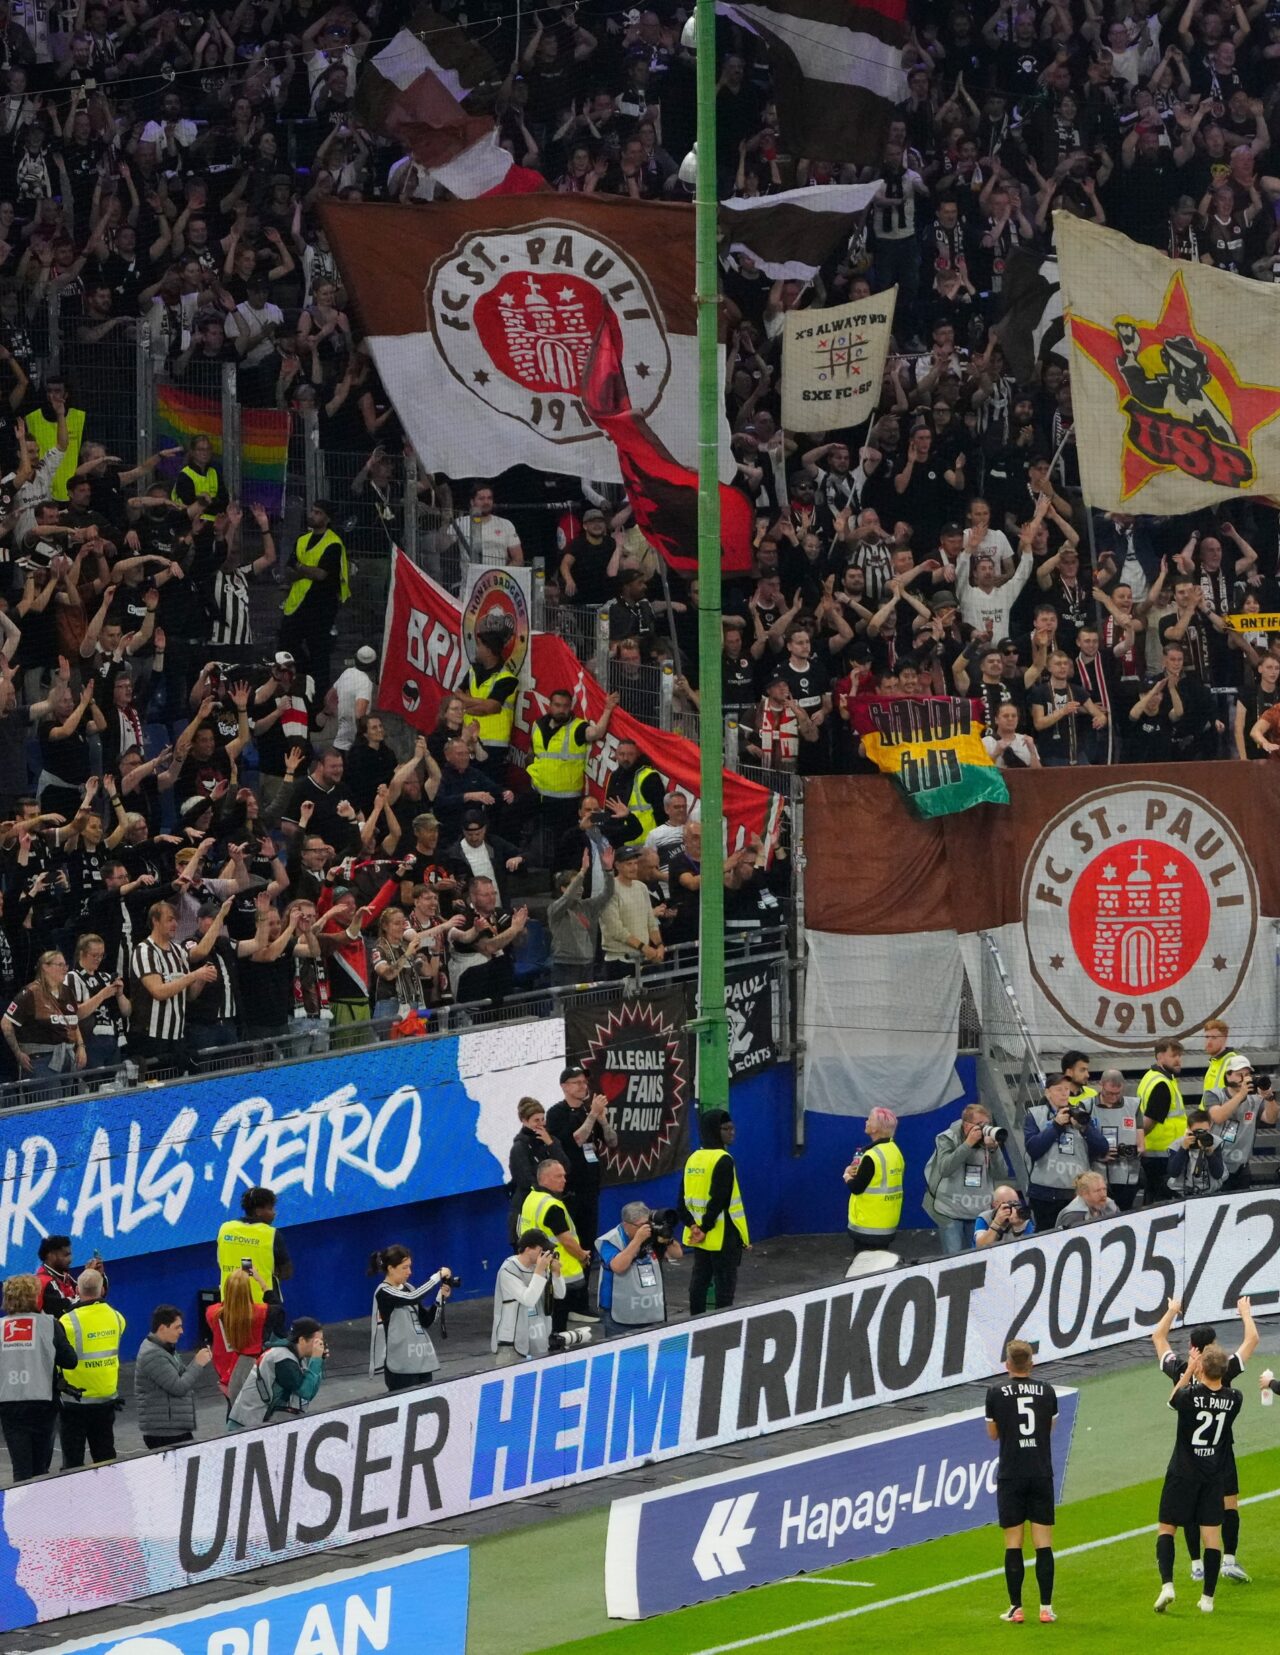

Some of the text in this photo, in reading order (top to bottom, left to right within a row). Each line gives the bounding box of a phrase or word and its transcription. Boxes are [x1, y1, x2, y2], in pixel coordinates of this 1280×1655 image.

[440, 235, 651, 330] FC ST. PAULI
[816, 315, 867, 336] ALWAYS
[802, 390, 832, 401] SXE
[1135, 411, 1246, 486] USP
[470, 575, 526, 617] HONEY BADGERS
[407, 607, 470, 693] BRI
[1036, 798, 1245, 908] FC ST. PAULI
[724, 972, 769, 1003] PAULI
[1094, 996, 1184, 1034] 1910
[605, 1050, 665, 1070] ILLEGALE
[627, 1074, 664, 1103] FANS
[621, 1107, 663, 1132] PAULI!
[71, 1107, 200, 1239] ALS
[211, 1083, 423, 1209] RETRO
[8, 1370, 30, 1385] 80
[85, 1360, 103, 1369] EVENT
[1001, 1384, 1044, 1396] ST. PAULI
[1194, 1397, 1235, 1411] ST. PAULI
[178, 1261, 988, 1574] UNSER HEIMTRIKOT
[1017, 1397, 1036, 1436] 5
[1191, 1411, 1226, 1446] 21
[1019, 1438, 1038, 1448] WAHL
